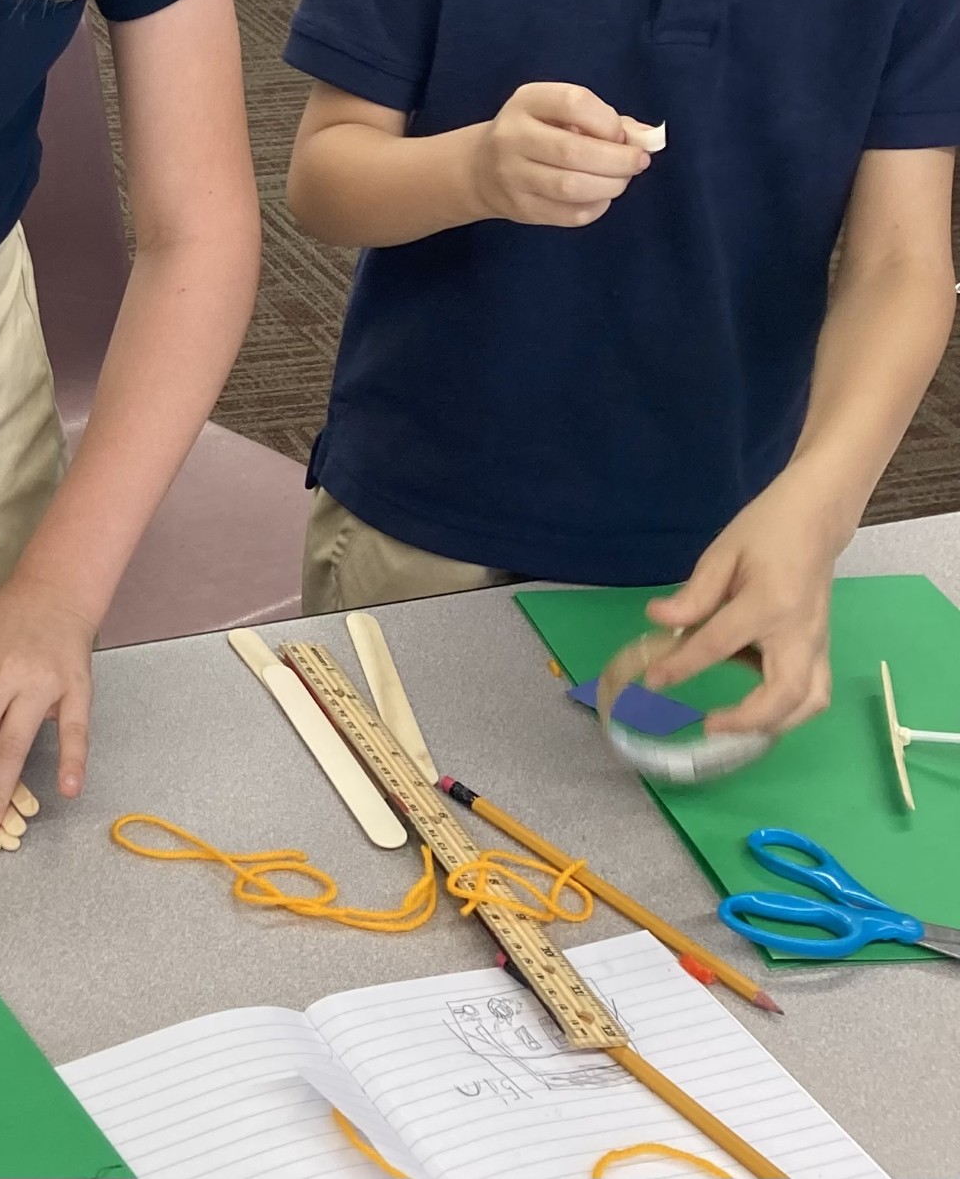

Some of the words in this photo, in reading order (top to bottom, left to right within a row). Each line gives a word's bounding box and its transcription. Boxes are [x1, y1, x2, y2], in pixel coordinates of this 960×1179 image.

[540, 946, 555, 957] 10
[570, 984, 584, 995] 11
[601, 1025, 616, 1037] 12
